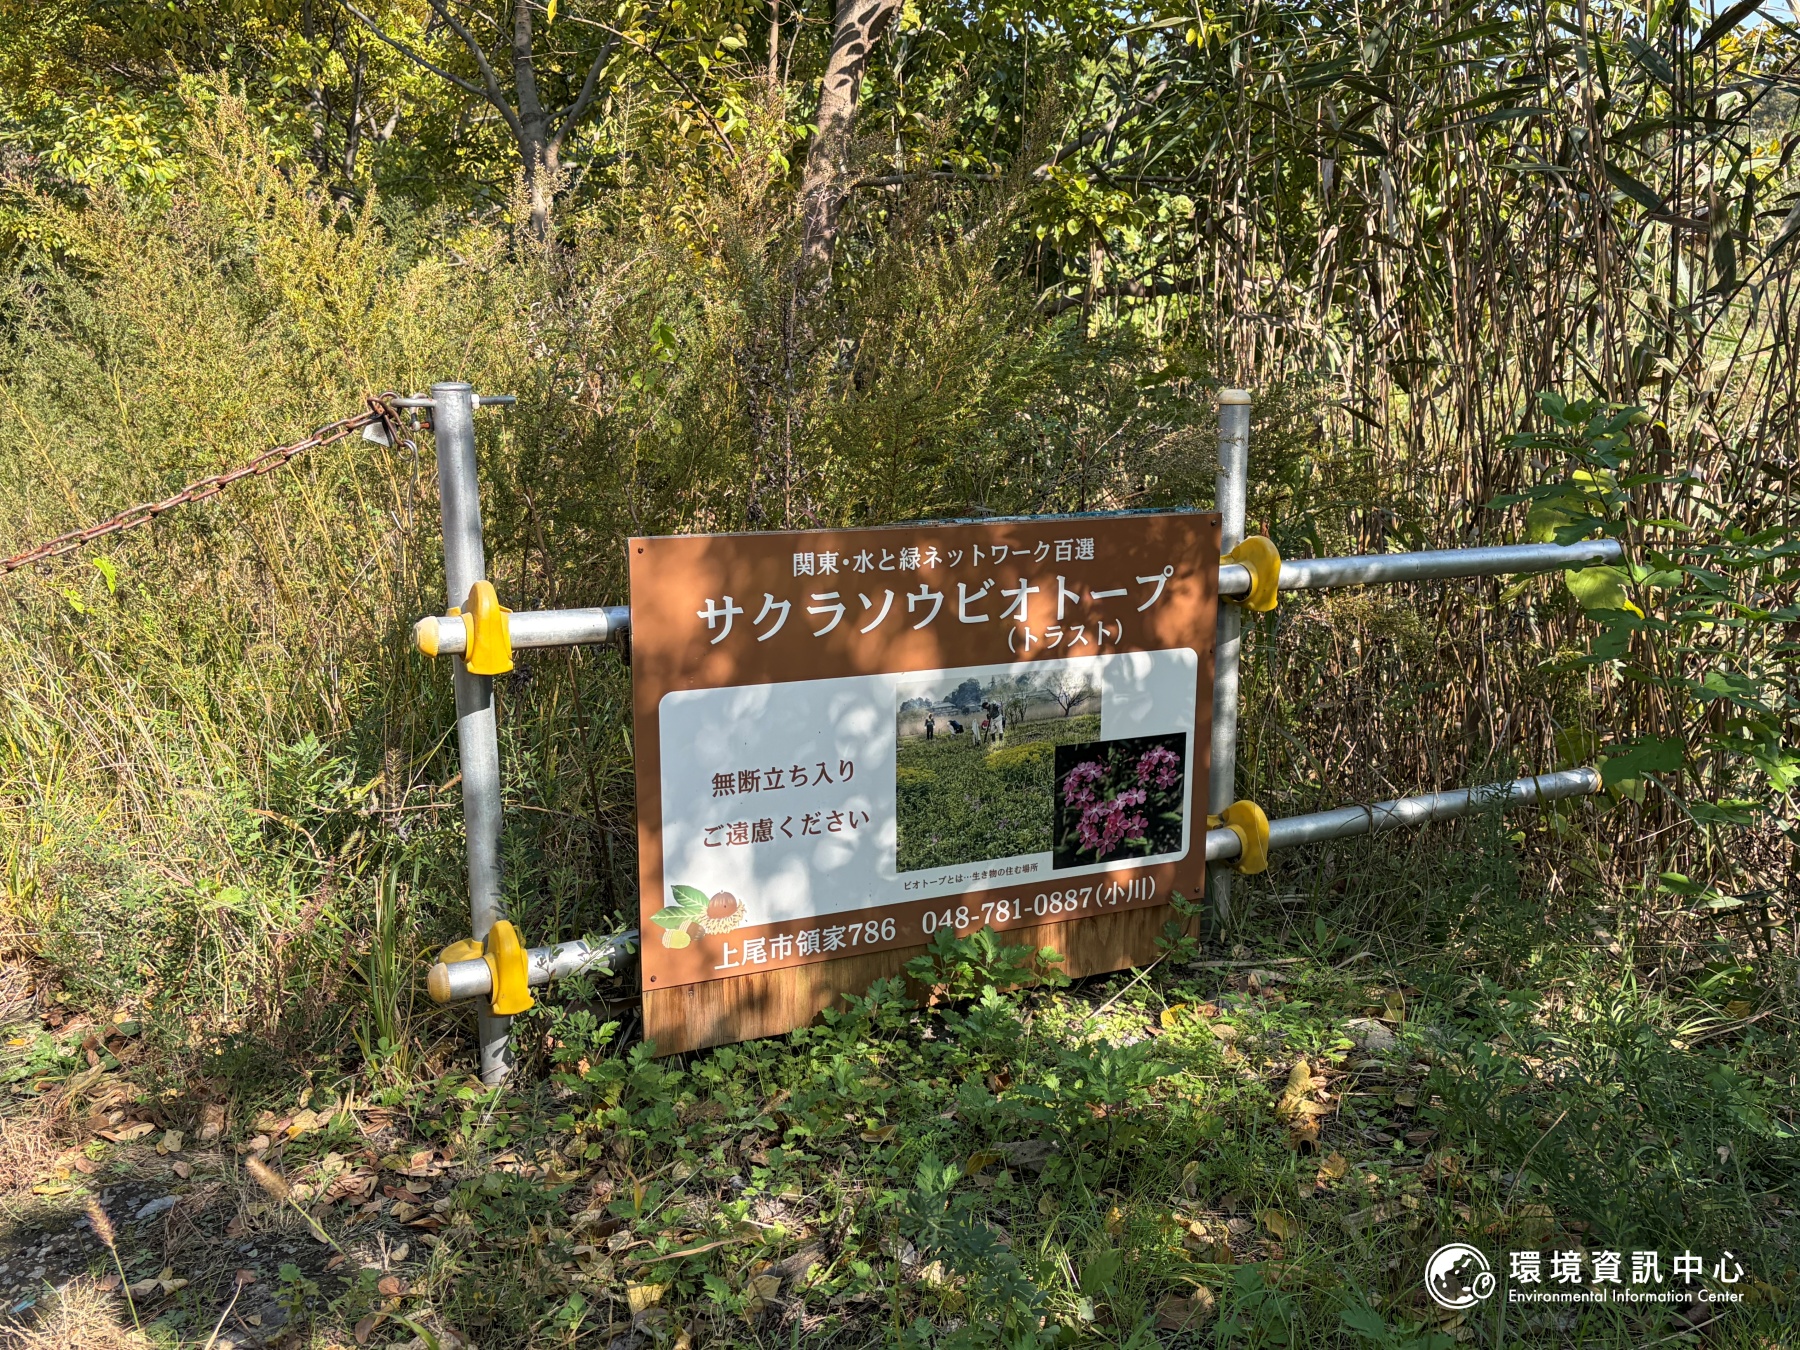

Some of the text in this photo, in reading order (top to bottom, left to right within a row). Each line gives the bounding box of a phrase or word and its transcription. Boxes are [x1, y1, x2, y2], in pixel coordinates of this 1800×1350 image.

[697, 565, 1175, 645] サクラソウビオトープ
[711, 759, 855, 798] 無断立ち入り
[703, 810, 871, 848] ご遠慮ください
[714, 917, 897, 970] 上尾市領家786
